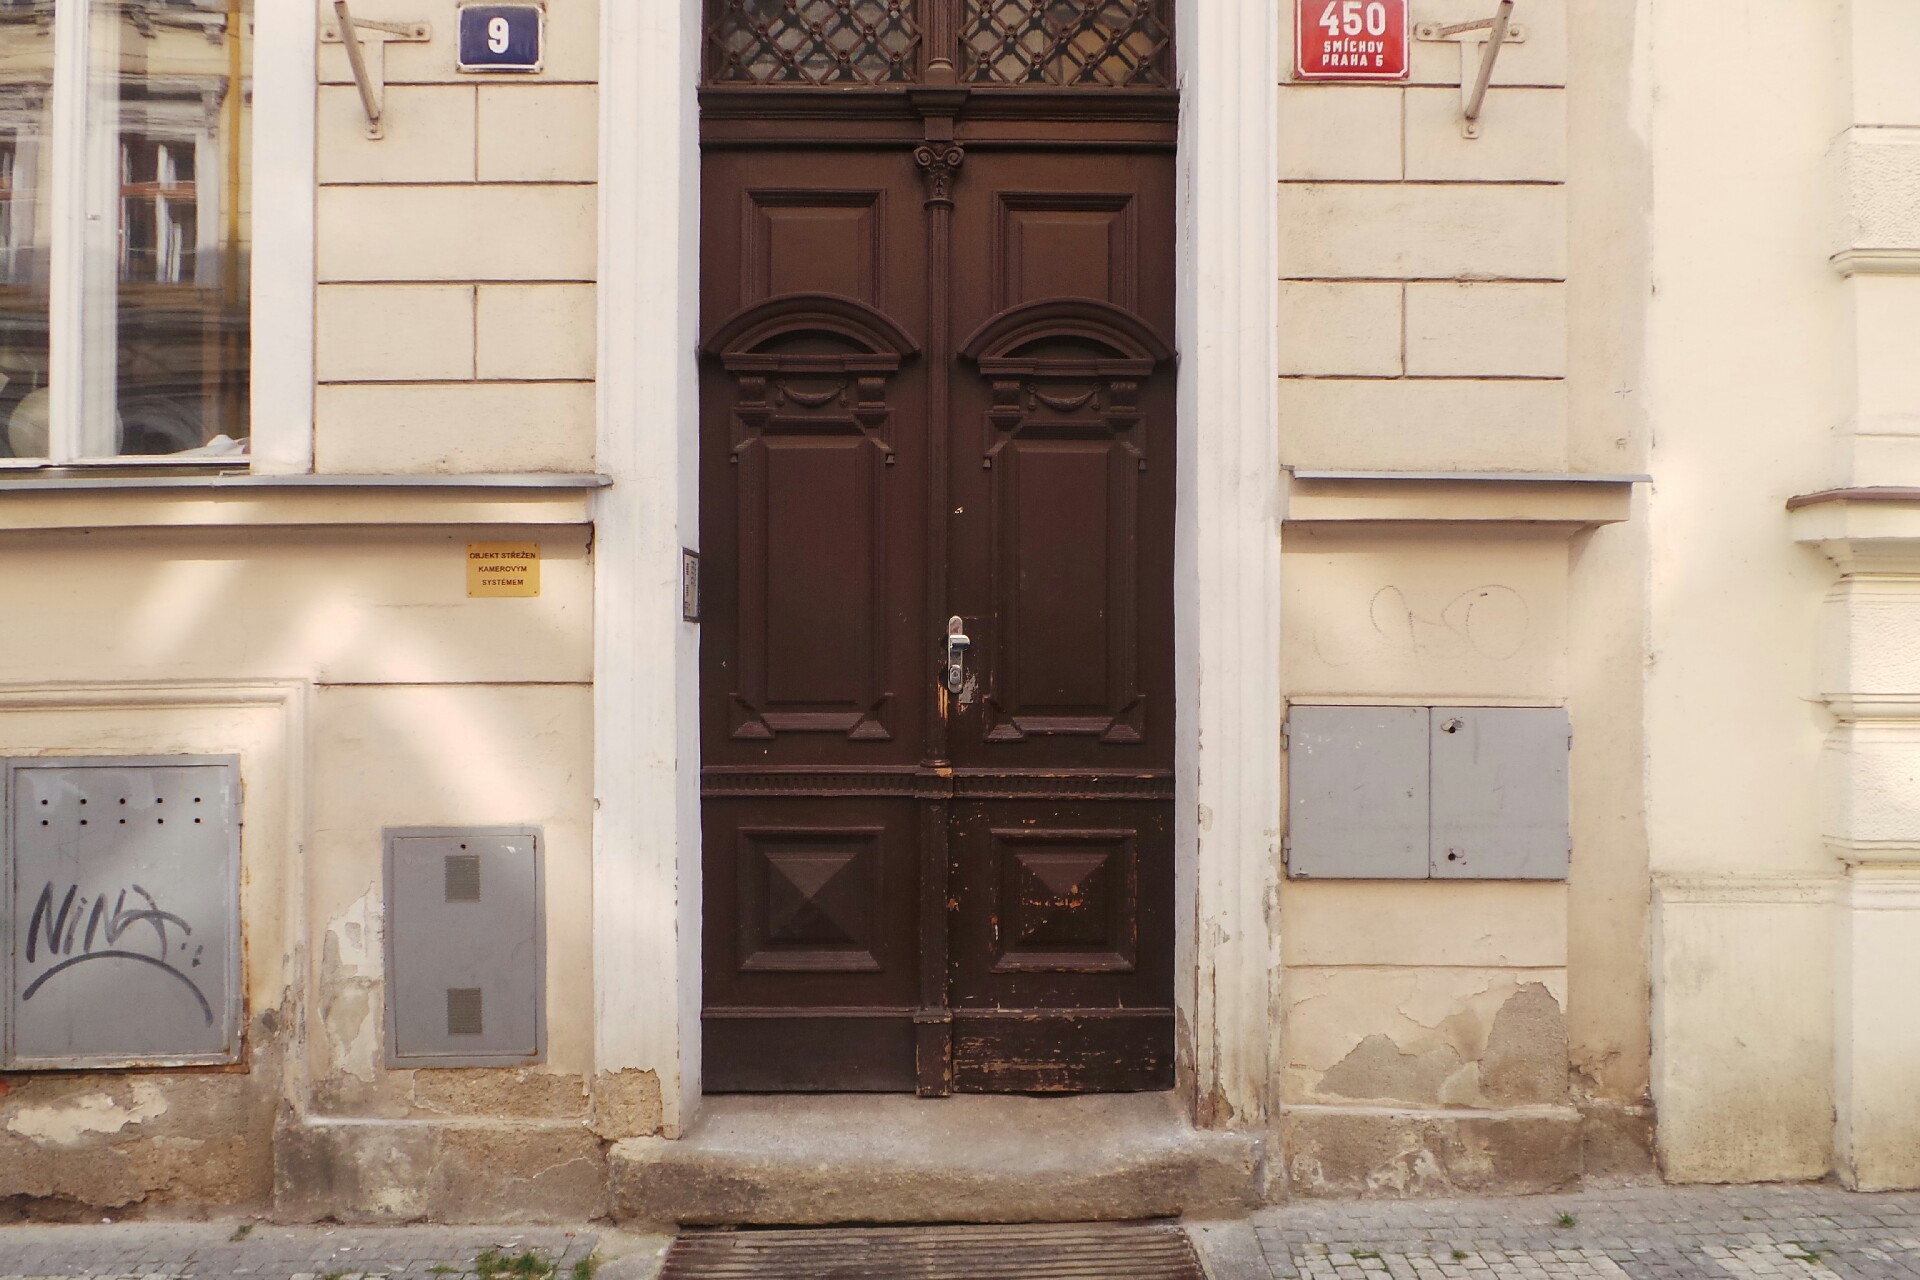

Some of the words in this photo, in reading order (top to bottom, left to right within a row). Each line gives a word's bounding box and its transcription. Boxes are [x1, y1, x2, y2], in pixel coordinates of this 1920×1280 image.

[1319, 1, 1386, 36] 450
[488, 17, 509, 54] 9
[1324, 38, 1384, 53] SMÍCHOV
[1322, 54, 1368, 66] PRAHA
